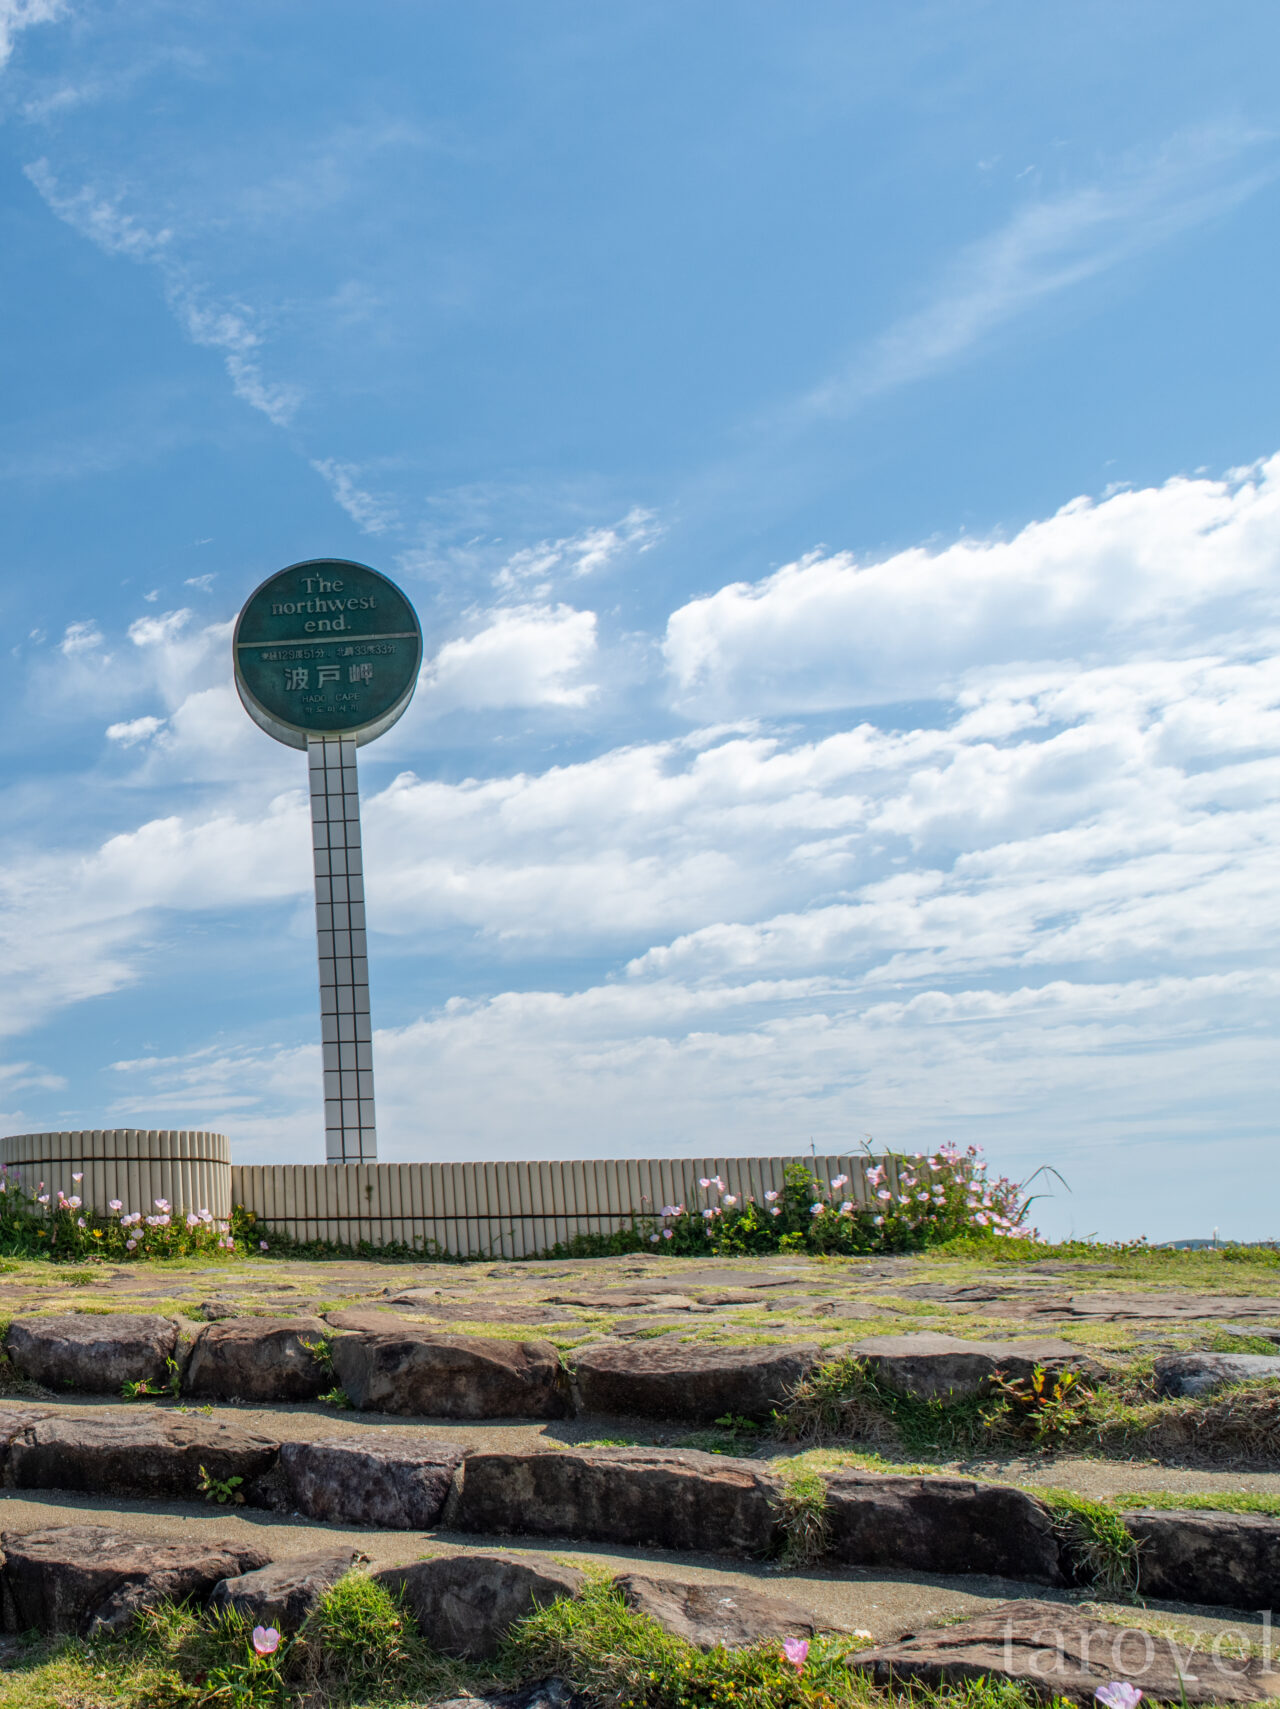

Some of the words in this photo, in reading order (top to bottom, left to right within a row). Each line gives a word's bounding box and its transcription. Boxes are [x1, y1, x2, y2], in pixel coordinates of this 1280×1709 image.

[301, 576, 344, 594] The
[272, 595, 377, 615] northwest
[304, 614, 352, 633] end.
[284, 663, 374, 692] 波戸岬
[302, 694, 327, 704] HADO
[335, 692, 361, 702] CAPE
